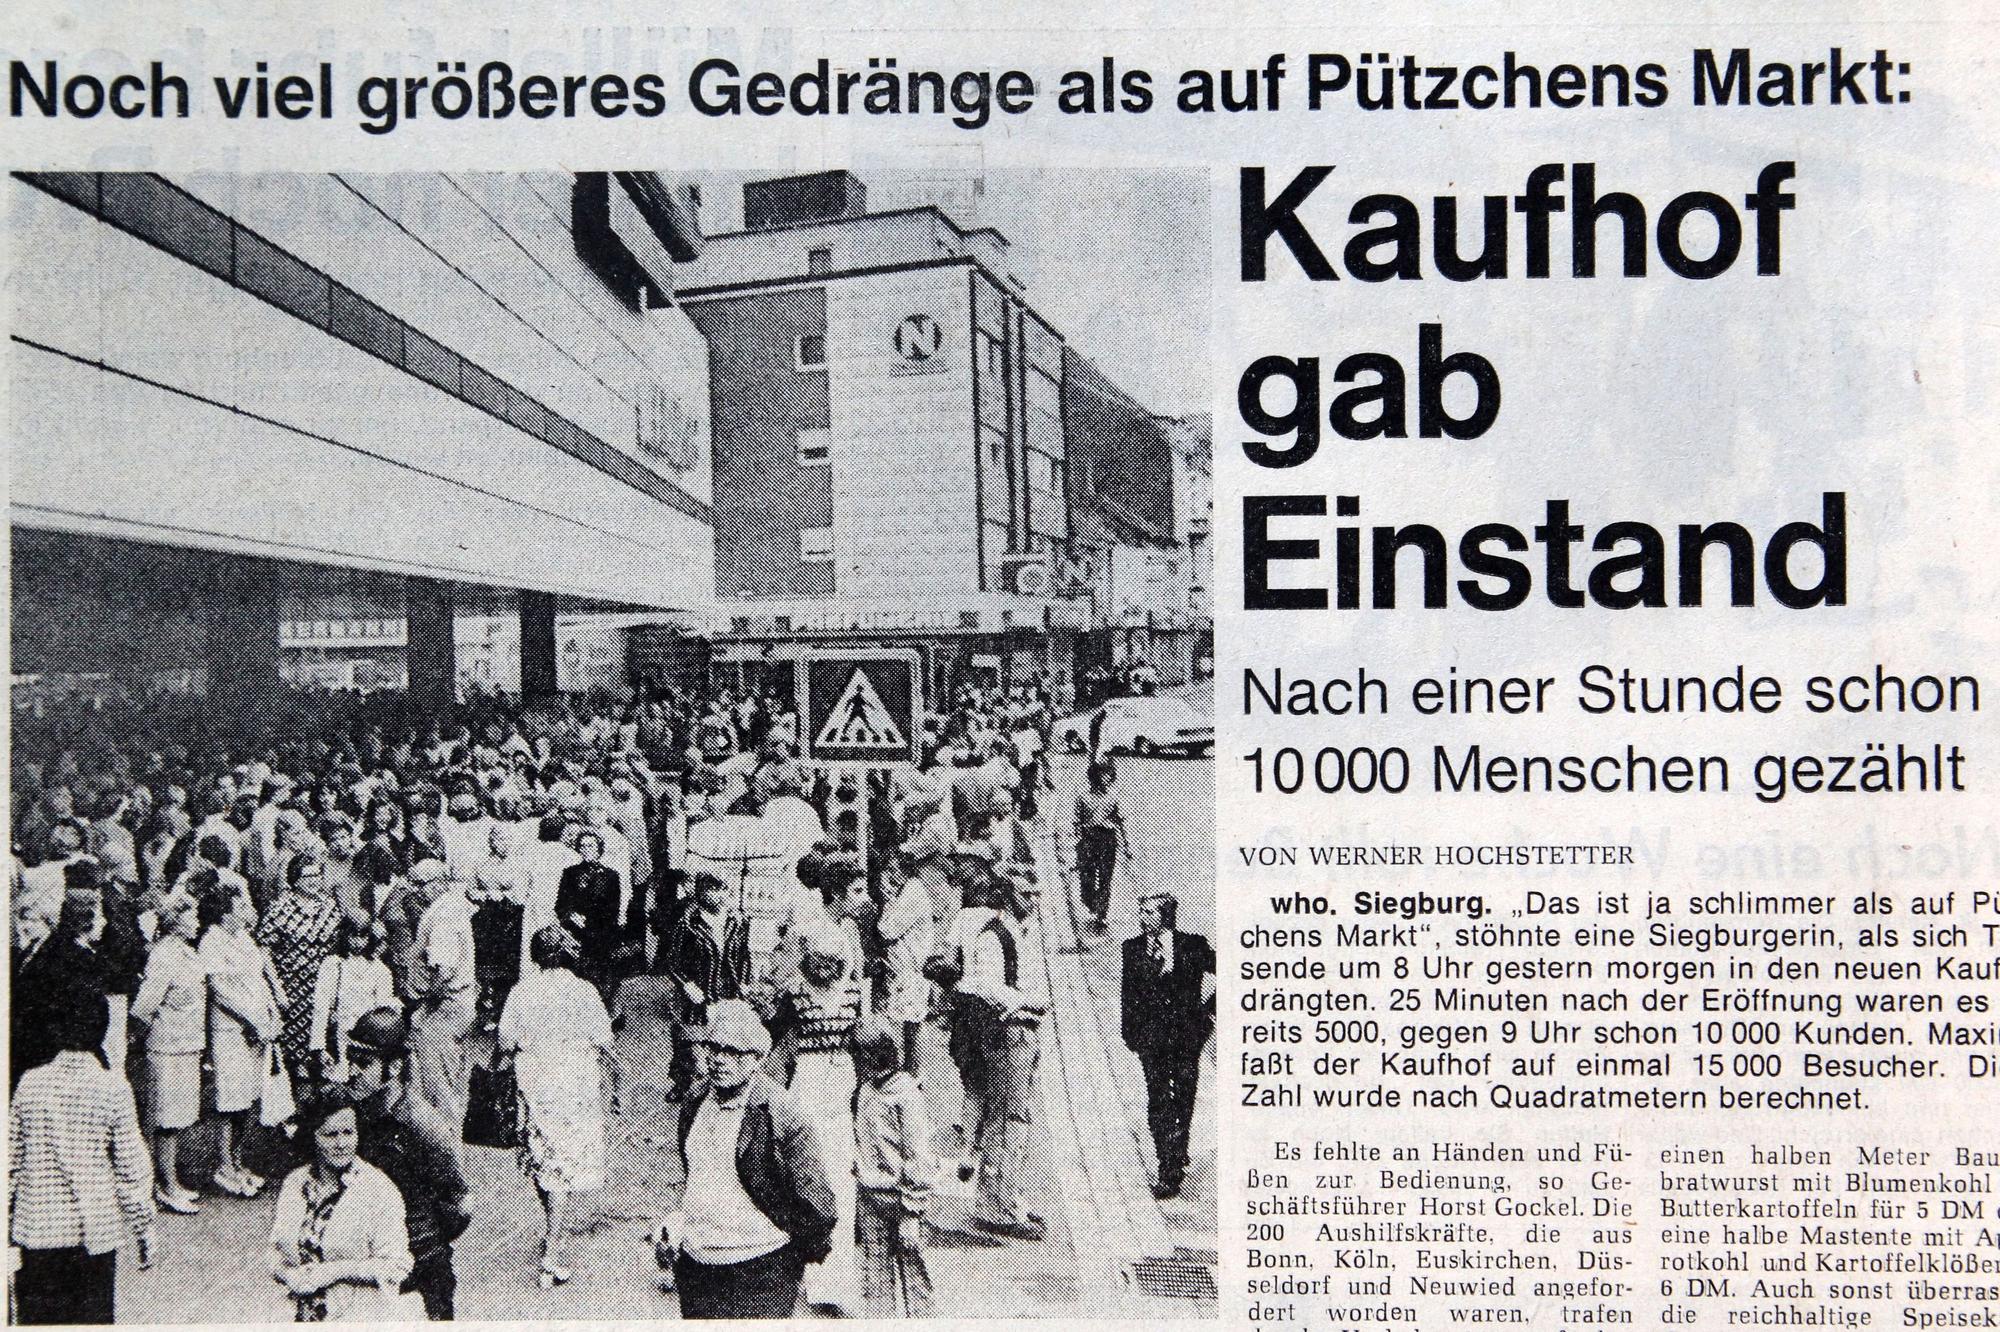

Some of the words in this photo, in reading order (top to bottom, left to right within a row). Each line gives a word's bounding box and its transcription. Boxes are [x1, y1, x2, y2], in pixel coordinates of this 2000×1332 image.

[9, 60, 189, 119] Noch
[213, 61, 333, 120] viel
[357, 60, 666, 135] größeres
[688, 57, 1035, 130] Gedränge
[1057, 56, 1154, 115] als
[1176, 53, 1287, 114] auf
[1307, 51, 1669, 112] Pützchens
[1693, 47, 1911, 108] Markt:
[1239, 160, 1796, 283] Kaufhof
[1237, 322, 1502, 470] gab
[1242, 491, 1847, 612] Einstand
[1243, 667, 1388, 716] Nach
[1411, 666, 1556, 716] einer
[1578, 664, 1782, 715] Stunde
[1805, 663, 1980, 714] schon
[1433, 744, 1729, 794] Menschen
[1753, 743, 1966, 804] gezählt
[1238, 846, 1298, 867] VON
[1308, 843, 1425, 866] WERNER
[1434, 845, 1635, 866] HOCHSTETTER
[1269, 891, 1337, 916] who.
[1354, 890, 1492, 920] Siegburg.
[1597, 890, 1630, 915] ist
[1645, 890, 1672, 920] ja
[1689, 890, 1837, 915] schlimmer
[1852, 890, 1894, 916] als
[1910, 891, 1956, 916] auf
[1240, 924, 1323, 949] chens
[1455, 922, 1561, 948] stöhnte
[1574, 923, 1635, 948] eine
[1648, 922, 1844, 953] Siegburgerin,
[1858, 923, 1899, 948] als
[1912, 923, 1968, 948] sich
[1240, 955, 1326, 981] sende
[1339, 960, 1381, 980] um
[1393, 955, 1410, 980] 8
[1423, 955, 1474, 980] Uhr
[1485, 957, 1593, 985] gestern
[1607, 960, 1715, 985] morgen
[1729, 955, 1754, 980] in
[1767, 956, 1820, 981] den
[1834, 961, 1921, 981] neuen
[1240, 987, 1376, 1017] drängten.
[1389, 988, 1422, 1012] 25
[1434, 987, 1548, 1013] Minuten
[1562, 987, 1628, 1012] nach
[1641, 988, 1689, 1012] der
[1702, 987, 1842, 1017] Eröffnung
[1855, 994, 1943, 1013] waren
[1956, 994, 1990, 1014] es
[1242, 1019, 1303, 1044] reits
[1314, 1020, 1386, 1047] 5000,
[1399, 1025, 1488, 1049] gegen
[1501, 1020, 1518, 1044] 9
[1530, 1019, 1582, 1045] Uhr
[1593, 1020, 1677, 1045] schon
[1795, 1021, 1913, 1046] Kunden.
[1928, 1021, 2000, 1046] Maxi
[1241, 1051, 1294, 1077] faßt
[1313, 1052, 1361, 1076] der
[1381, 1051, 1492, 1077] Kaufhof
[1511, 1052, 1556, 1077] auf
[1576, 1052, 1670, 1077] einmal
[1803, 1053, 1945, 1079] Besucher.
[1968, 1054, 1997, 1079] Di
[1241, 1083, 1302, 1108] Zahl
[1312, 1084, 1401, 1108] wurde
[1412, 1084, 1478, 1109] nach
[1490, 1084, 1707, 1110] Quadratmetern
[1719, 1085, 1869, 1111] berechnet.
[1273, 1141, 1301, 1162] Es
[1313, 1140, 1381, 1162] fehlte
[1392, 1147, 1421, 1162] an
[1431, 1141, 1525, 1162] Händen
[1536, 1141, 1582, 1163] und
[1593, 1142, 1633, 1163] Fü-
[1660, 1143, 1725, 1165] einen
[1750, 1143, 1832, 1166] halben
[1856, 1145, 1931, 1166] Meter
[1246, 1168, 1289, 1189] ßen
[1315, 1173, 1354, 1190] zur
[1379, 1169, 1511, 1194] Bedienung,
[1538, 1175, 1564, 1191] so
[1591, 1170, 1632, 1191] Ge-
[1659, 1170, 1779, 1192] bratwurst
[1792, 1171, 1832, 1193] mit
[1845, 1171, 1992, 1194] Blumenkohl
[1246, 1194, 1407, 1216] schäftsführer
[1419, 1196, 1486, 1217] Horst
[1494, 1195, 1584, 1217] Gockel.
[1592, 1197, 1632, 1218] Die
[1659, 1197, 1857, 1219] Butterkartoffeln
[1870, 1198, 1906, 1220] für
[1916, 1200, 1929, 1220] 5
[1940, 1200, 1985, 1220] DM
[1246, 1223, 1285, 1242] 200
[1314, 1221, 1494, 1243] Aushilfskräfte,
[1525, 1222, 1561, 1244] die
[1592, 1227, 1632, 1244] aus
[1661, 1224, 1710, 1245] eine
[1722, 1224, 1788, 1245] halbe
[1800, 1225, 1912, 1246] Mastente
[1923, 1226, 1964, 1247] mit
[1975, 1227, 2000, 1248] A
[1246, 1248, 1314, 1269] Bonn,
[1333, 1248, 1396, 1272] Köln,
[1416, 1248, 1557, 1271] Euskirchen,
[1577, 1250, 1633, 1271] Düs-
[1660, 1250, 1749, 1272] rotkohl
[1762, 1251, 1808, 1272] und
[1247, 1274, 1332, 1296] seldorf
[1348, 1275, 1392, 1296] und
[1409, 1275, 1516, 1297] Neuwied
[1533, 1276, 1633, 1301] angefor-
[1660, 1279, 1673, 1297] 6
[1685, 1278, 1736, 1298] DM.
[1749, 1277, 1815, 1299] Auch
[1829, 1281, 1893, 1300] sonst
[1248, 1301, 1296, 1322] dert
[1325, 1301, 1417, 1323] worden
[1449, 1308, 1530, 1325] waren,
[1562, 1303, 1633, 1324] trafen
[1661, 1303, 1697, 1324] die
[1727, 1304, 1872, 1330] reichhaltige
